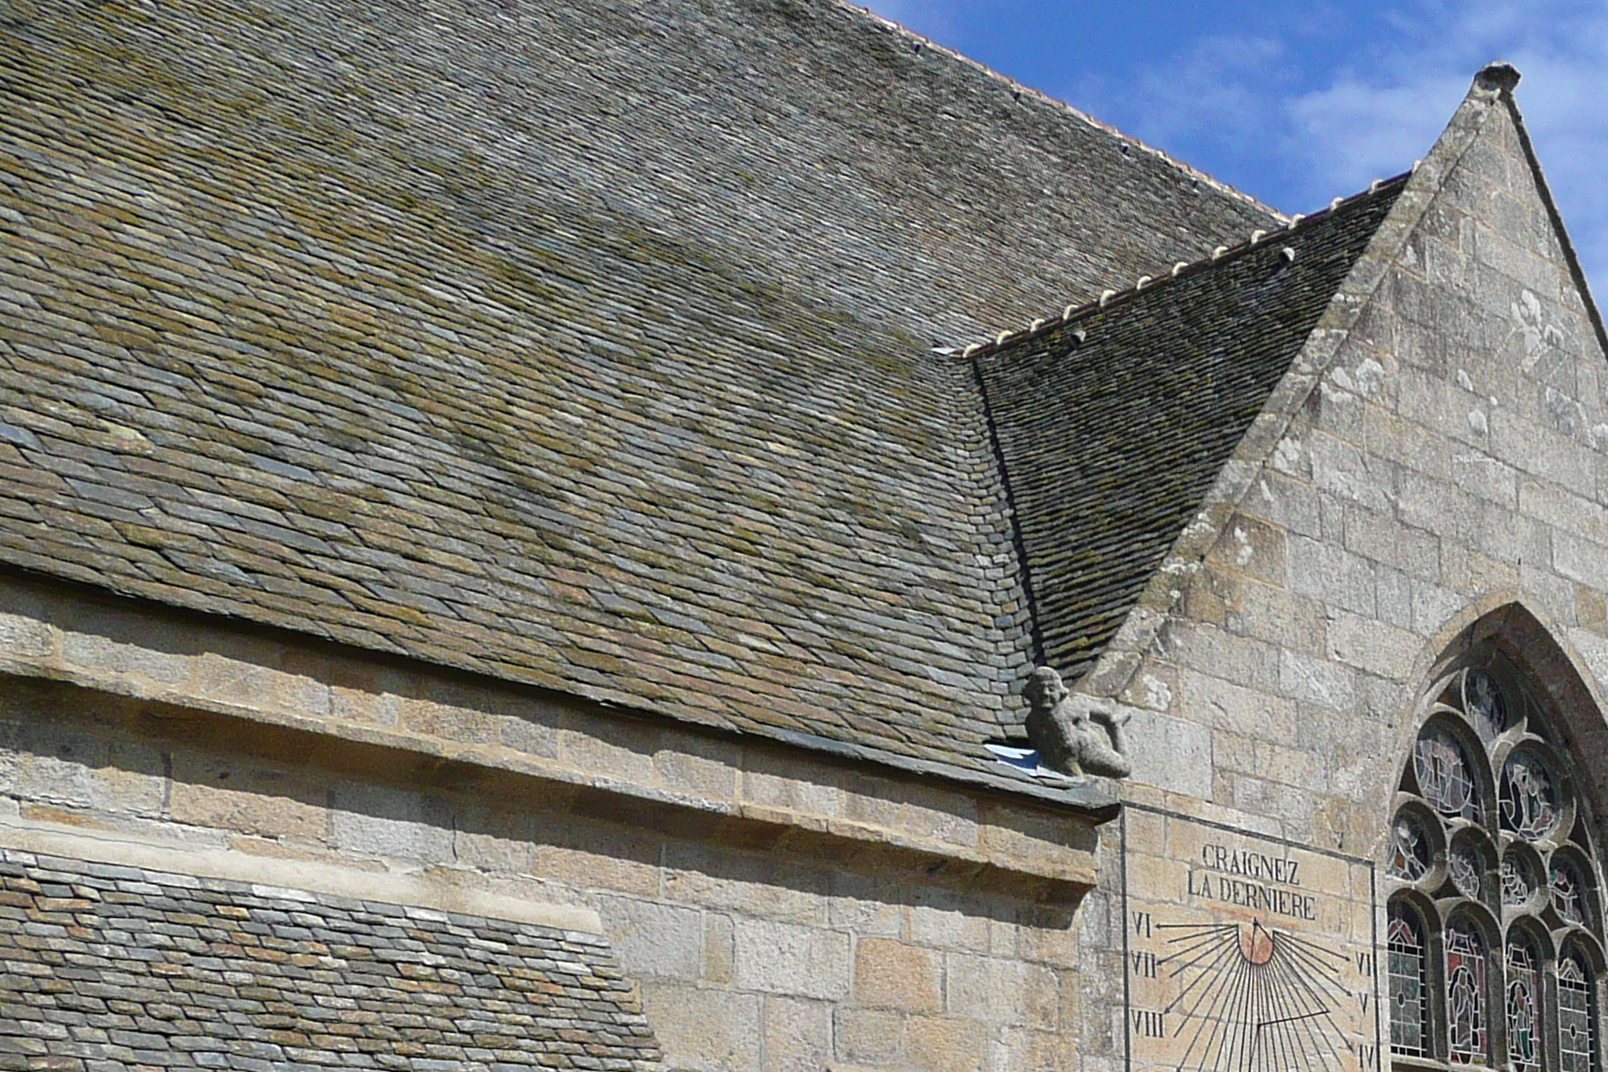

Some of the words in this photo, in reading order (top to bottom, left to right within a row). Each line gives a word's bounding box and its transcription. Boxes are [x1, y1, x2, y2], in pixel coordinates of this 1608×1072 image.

[1202, 843, 1300, 886] CRAIGNEZ
[1187, 869, 1213, 899] LA
[1219, 876, 1316, 921] DERNIERE
[1132, 911, 1151, 938] VI
[1130, 949, 1156, 979] VII
[1355, 951, 1372, 977] VI
[1358, 992, 1368, 1017] V
[1130, 1009, 1164, 1038] VIII
[1359, 1044, 1374, 1069] IV
